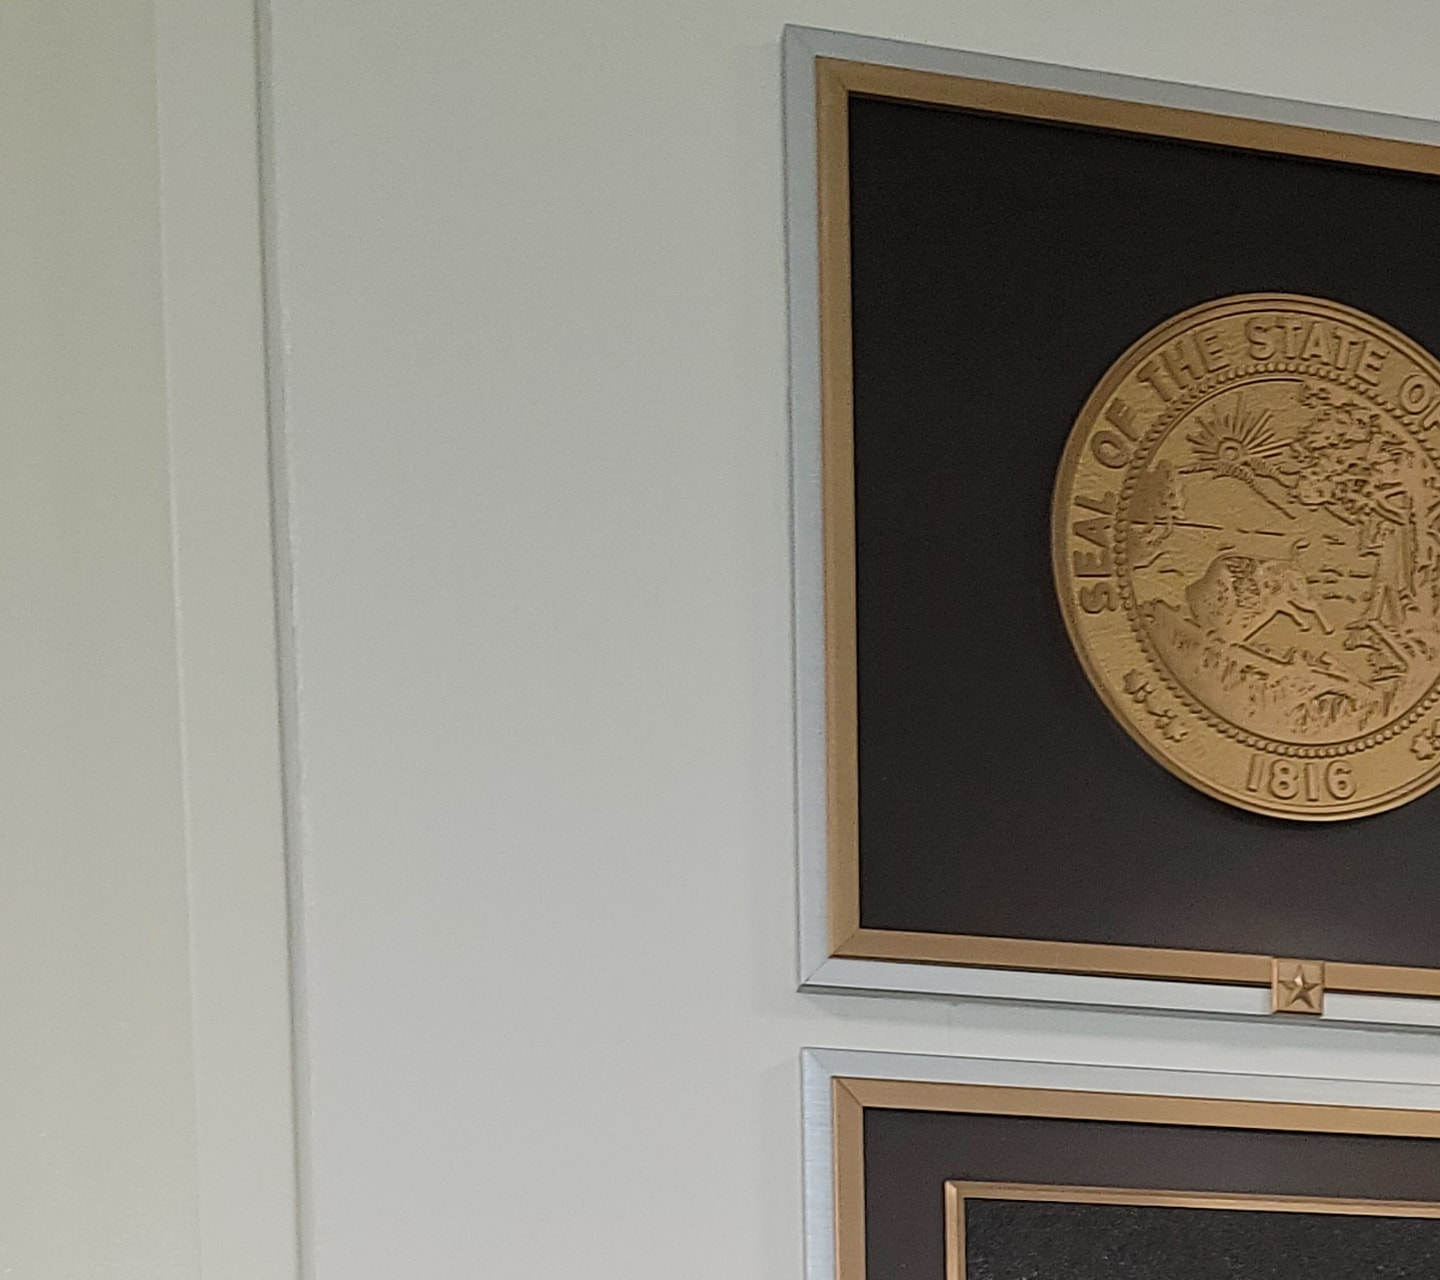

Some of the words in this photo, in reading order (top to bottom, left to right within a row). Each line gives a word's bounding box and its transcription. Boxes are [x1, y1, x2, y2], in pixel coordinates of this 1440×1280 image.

[1138, 330, 1231, 396] THE
[1244, 316, 1390, 386] STATE
[1091, 398, 1143, 471] OF
[1074, 491, 1118, 615] SEAL
[1246, 754, 1357, 800] 1816
